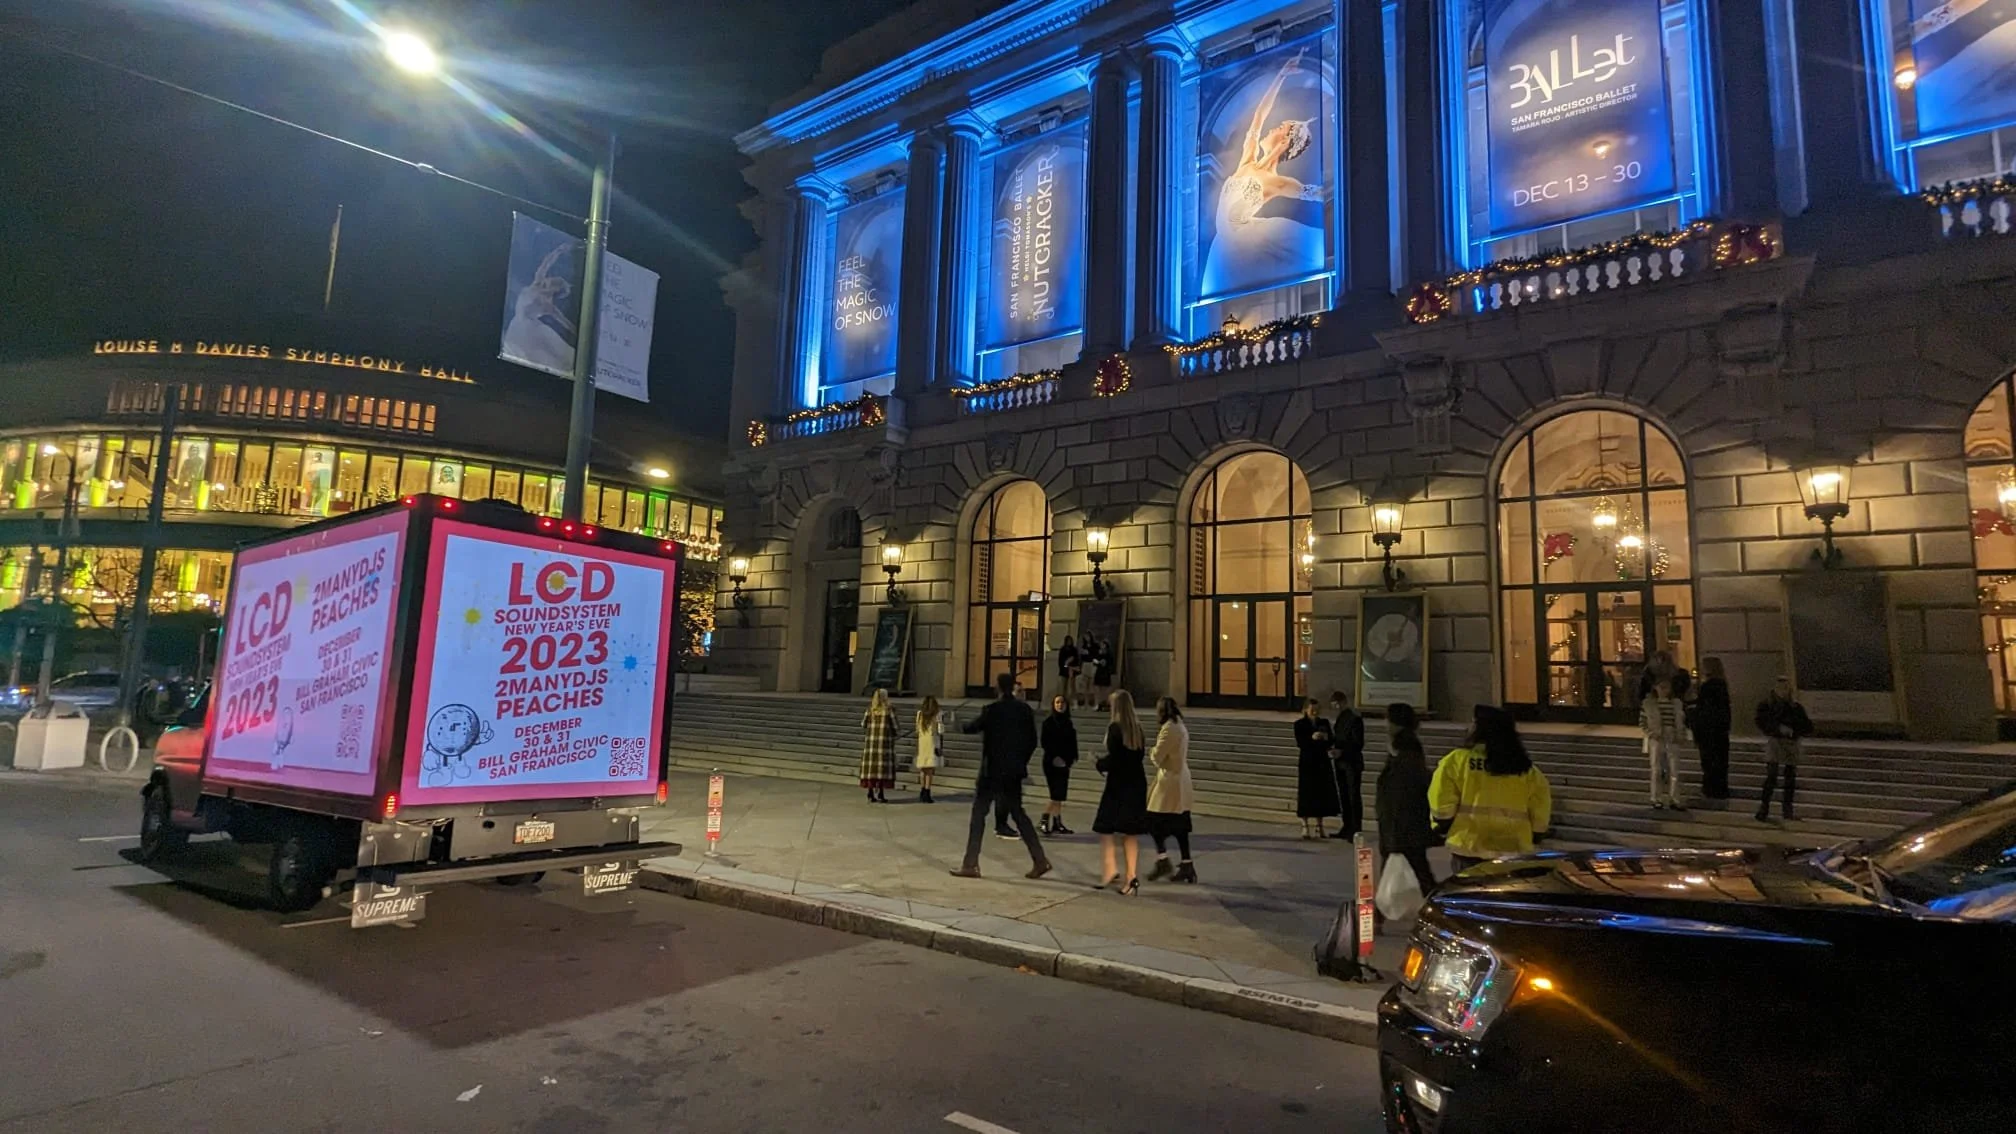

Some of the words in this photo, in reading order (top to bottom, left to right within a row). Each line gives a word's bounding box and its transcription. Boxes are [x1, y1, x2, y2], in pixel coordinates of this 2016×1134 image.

[1511, 114, 1532, 126] SAN
[1533, 97, 1593, 118] FRANCISCO
[1595, 83, 1637, 102] BALLET
[1512, 120, 1540, 133] TAMARA
[1565, 105, 1598, 119] ARTISTIC
[1599, 92, 1638, 109] DIRECTOR
[1014, 168, 1024, 211] BALLET
[1513, 181, 1559, 207] DEC
[1564, 174, 1589, 194] 13
[1612, 161, 1641, 183] 30
[1033, 145, 1061, 321] NUTCRACKER
[839, 254, 866, 273] FEEL
[1011, 217, 1022, 287] FRANCISCO
[836, 288, 877, 312] MAGIC
[837, 273, 861, 292] THE
[835, 314, 852, 330] OF
[855, 302, 897, 326] SNOW
[1010, 297, 1019, 319] SAN
[94, 340, 159, 354] LOUISE
[196, 342, 271, 358] DAVIES
[285, 348, 404, 373] SYMPHONY
[419, 363, 476, 384] HALL
[312, 547, 386, 606] 2MANYDJS
[508, 561, 615, 606] LCD
[235, 580, 293, 657] LCD
[310, 577, 381, 634] PEACHES
[494, 603, 621, 624] SOUNDSYSTEM
[318, 626, 362, 660] DECEMBER
[504, 624, 536, 636] NEW
[540, 620, 584, 634] YEAR'S
[588, 618, 610, 629] EVE
[227, 633, 291, 679] SOUNDSYSTEM
[321, 657, 333, 673] 30
[342, 647, 352, 665] 31
[499, 631, 609, 674] 2023
[296, 683, 310, 702] BILL
[311, 665, 349, 694] GRAHAM
[351, 651, 379, 674] CIVIC
[300, 698, 315, 715] SAN
[317, 672, 368, 708] FRANCISCO
[495, 669, 609, 698] 2MANYDJS
[222, 675, 280, 741] 2023
[497, 687, 605, 720] PEACHES
[515, 717, 582, 739] DECEMBER
[523, 737, 538, 749] 30
[543, 734, 552, 744] &
[557, 730, 571, 741] 31
[478, 756, 504, 770] BILL
[510, 743, 569, 764] GRAHAM
[573, 734, 609, 750] CIVIC
[489, 766, 517, 780] SAN
[522, 749, 598, 773] FRANCISCO
[585, 871, 633, 889] SUPREME
[356, 897, 417, 918] SUPREME
